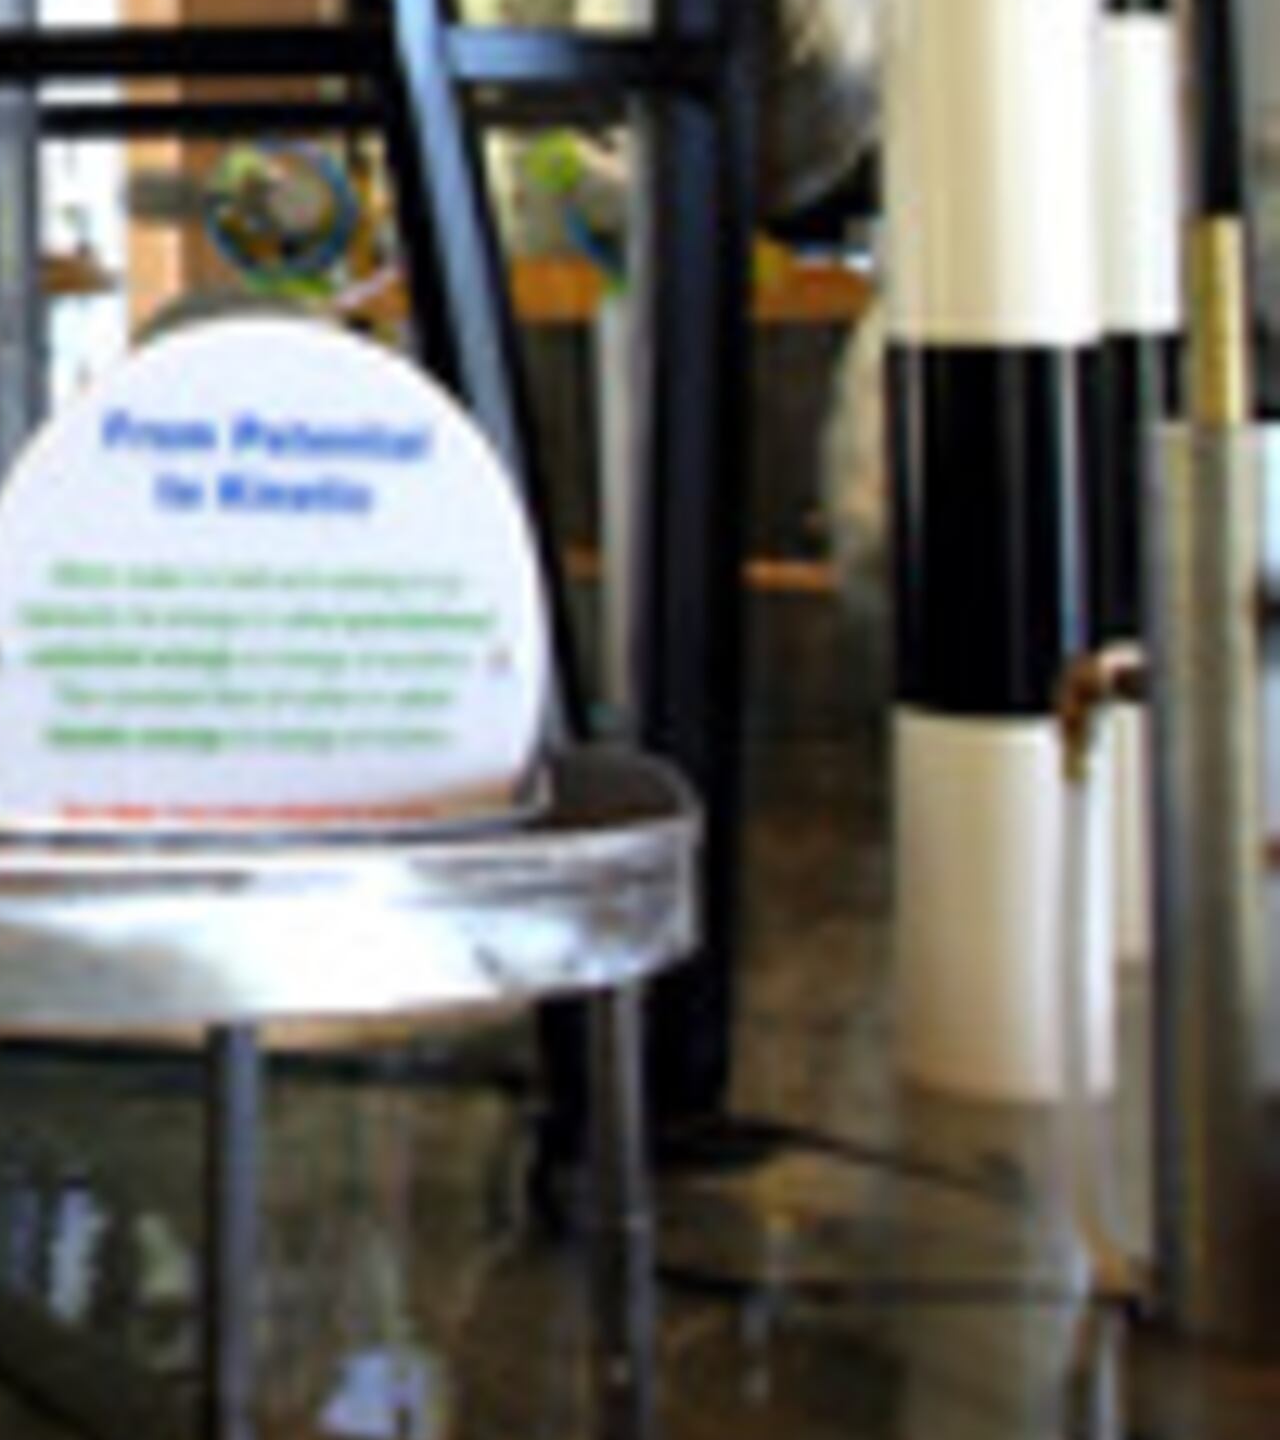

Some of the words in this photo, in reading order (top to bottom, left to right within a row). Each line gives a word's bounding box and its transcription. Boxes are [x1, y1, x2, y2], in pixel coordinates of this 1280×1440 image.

[100, 408, 218, 452] From
[231, 409, 433, 465] Potential
[152, 470, 204, 513] to
[216, 470, 375, 516] Kinetic
